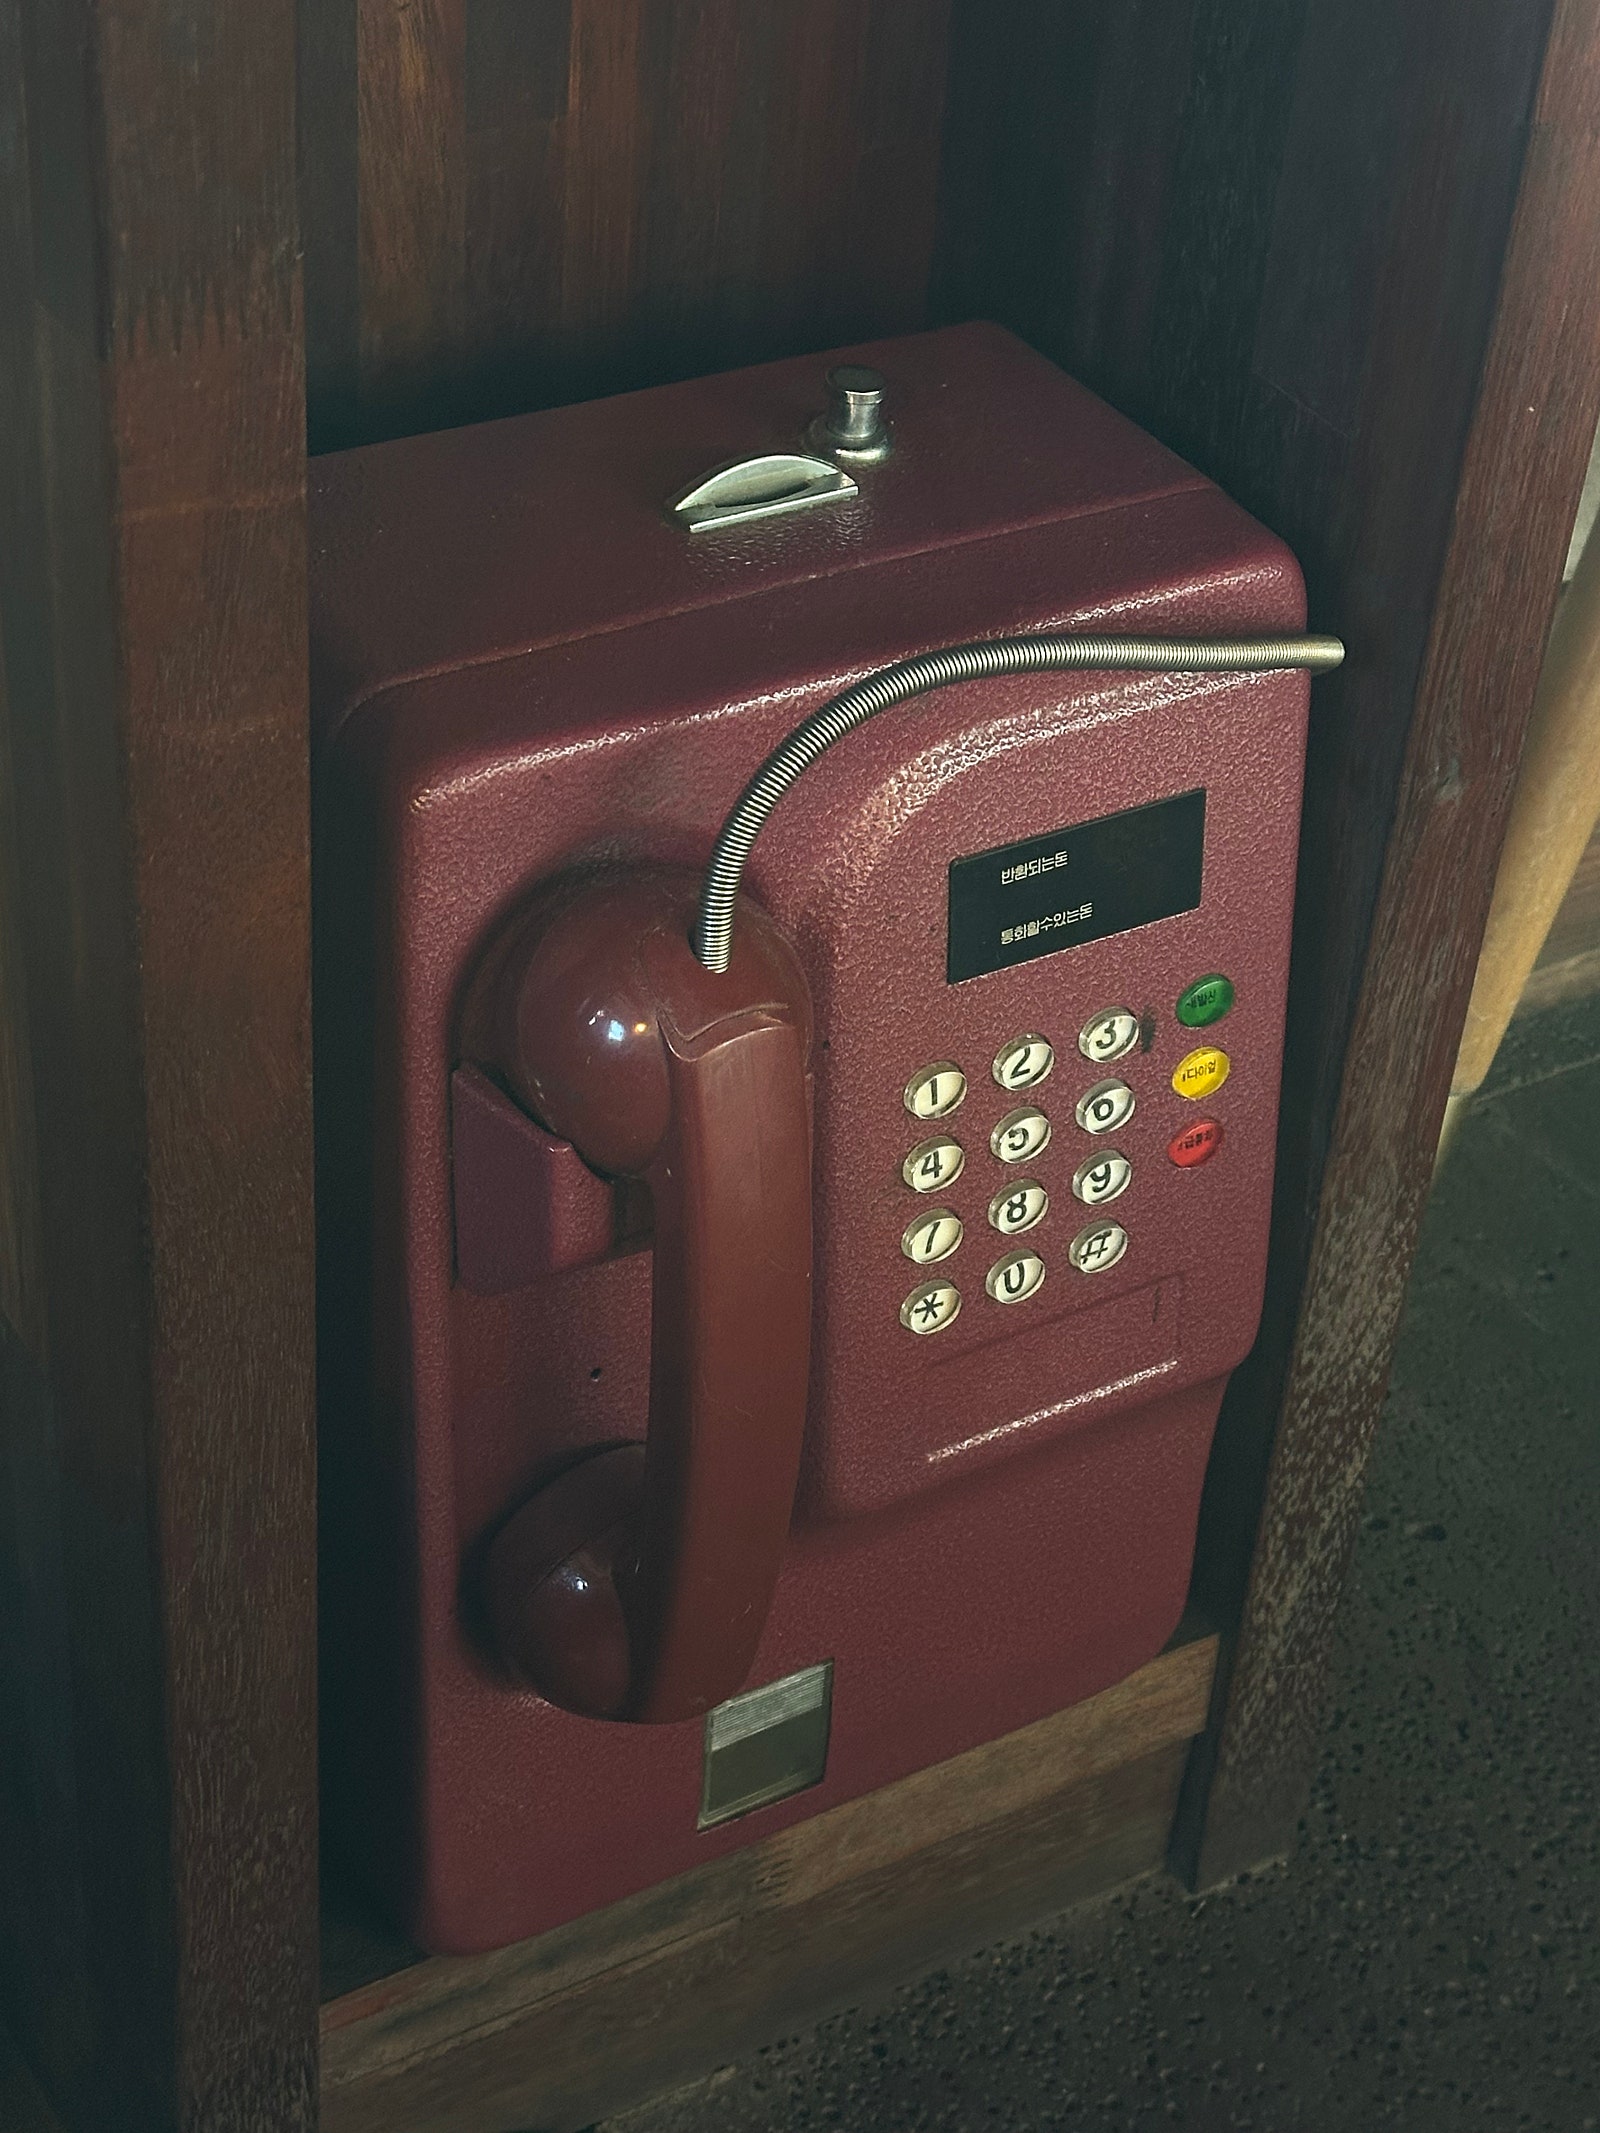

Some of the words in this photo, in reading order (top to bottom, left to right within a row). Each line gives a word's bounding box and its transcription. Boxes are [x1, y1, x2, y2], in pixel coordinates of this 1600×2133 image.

[1000, 850, 1068, 885] 반환되는돈
[1000, 902, 1093, 945] 통화할수있는돈
[1011, 1046, 1031, 1079] 2
[1096, 1019, 1117, 1050] 3
[1182, 1060, 1216, 1081] 다이얼
[921, 1150, 943, 1180] 4
[1006, 1192, 1027, 1224] 8
